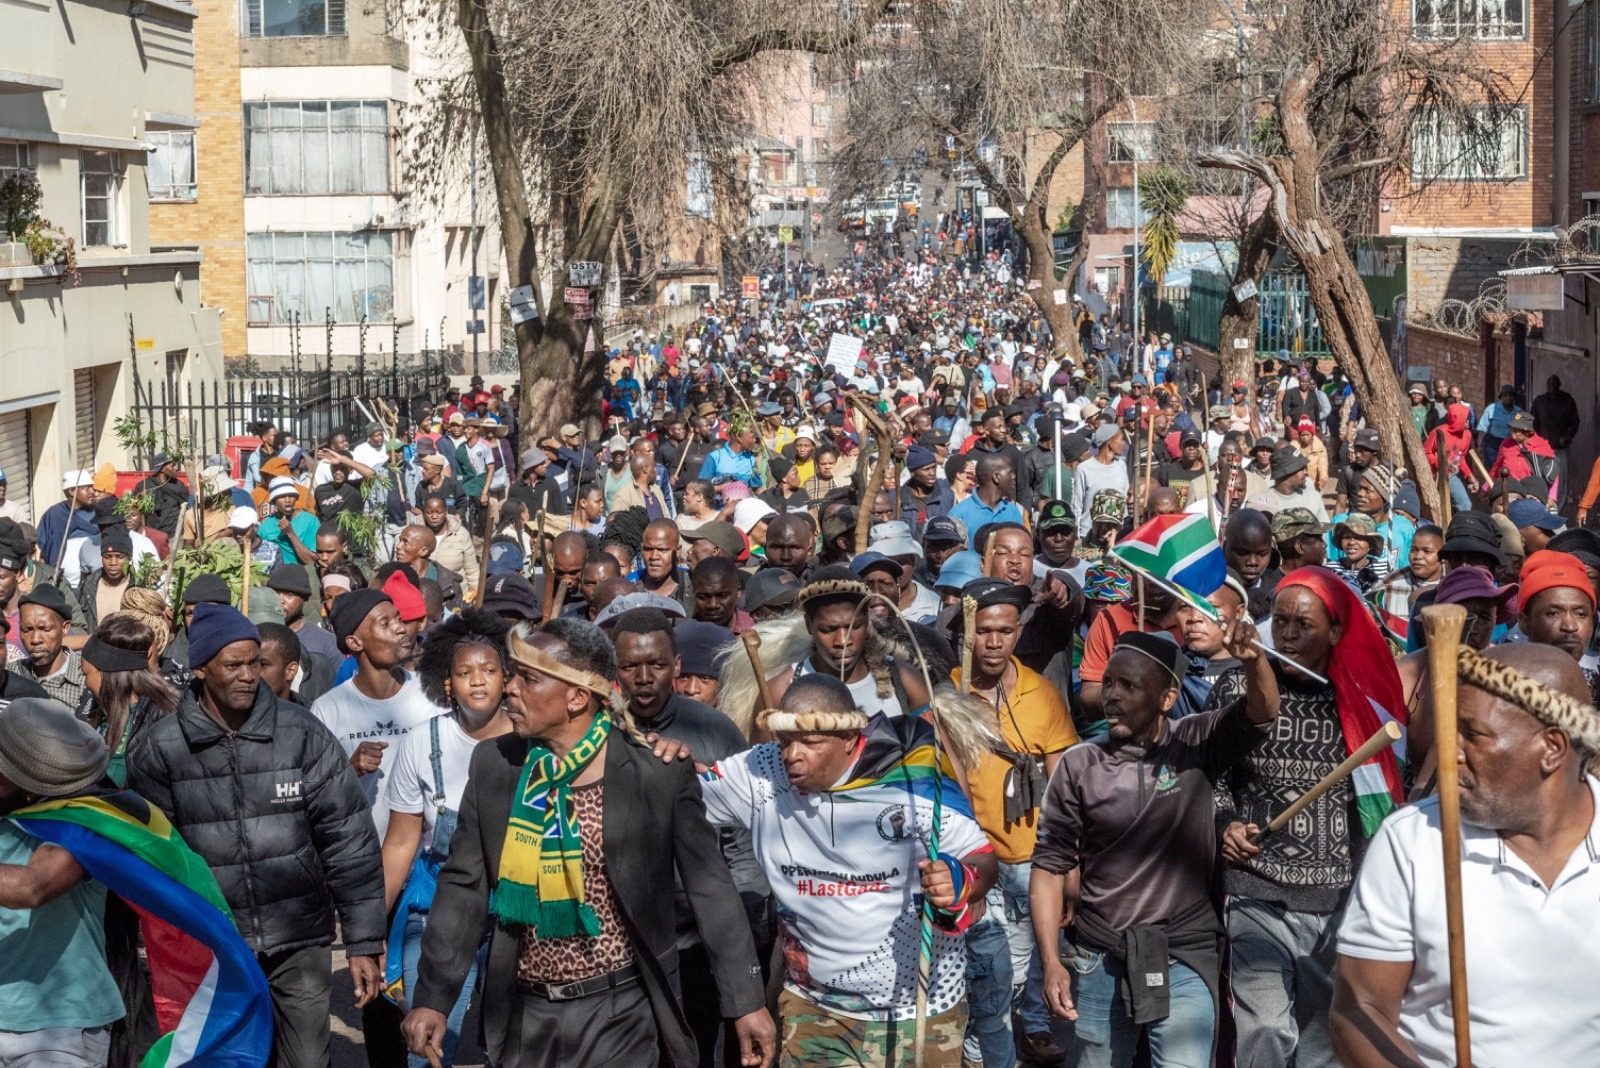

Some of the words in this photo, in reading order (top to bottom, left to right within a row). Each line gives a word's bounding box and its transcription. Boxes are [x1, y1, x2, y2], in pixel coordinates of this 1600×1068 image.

[571, 262, 598, 270] DSTV
[349, 729, 383, 740] RELAY
[387, 726, 412, 737] JEA
[275, 781, 300, 798] HH
[514, 830, 538, 848] SOUTH
